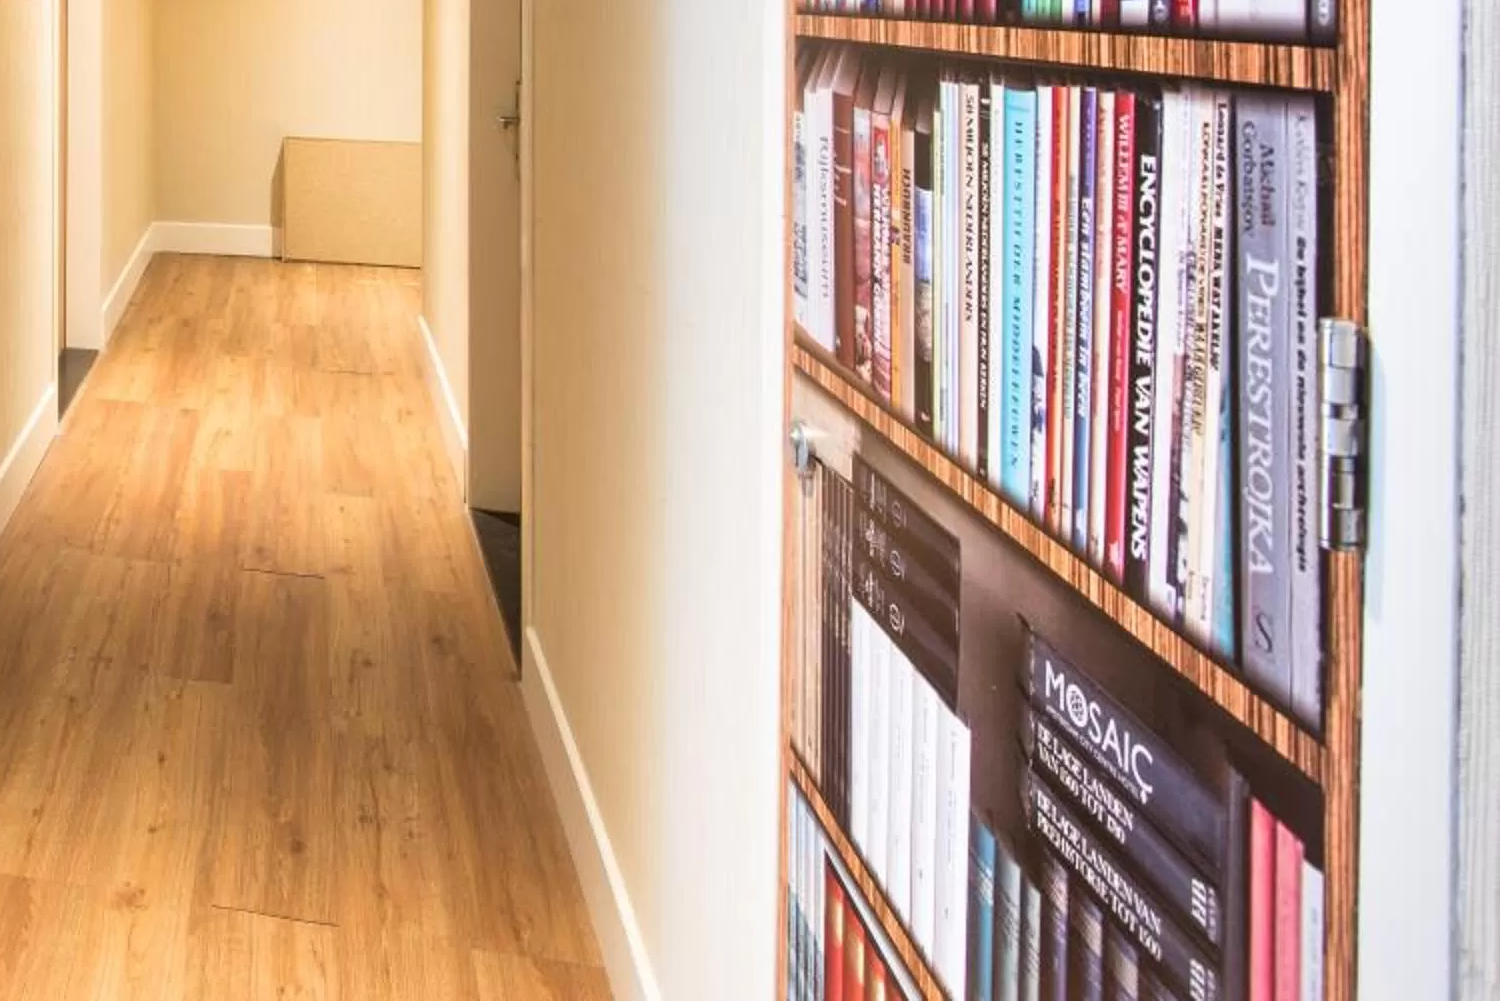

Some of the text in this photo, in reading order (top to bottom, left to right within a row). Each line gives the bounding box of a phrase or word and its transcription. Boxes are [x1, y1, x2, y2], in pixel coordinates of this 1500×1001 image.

[965, 118, 974, 188] MILJOEN
[1117, 113, 1130, 191] WILLEM
[1216, 103, 1228, 161] Leonard
[817, 135, 829, 298] Rijksmuseum
[1081, 196, 1092, 237] Een
[1215, 183, 1225, 217] Vries
[1259, 142, 1276, 227] Michail
[873, 184, 882, 278] HERMANN
[964, 193, 974, 324] NEDERLANDERS
[1013, 244, 1022, 286] DER
[1115, 236, 1128, 294] MARY
[1079, 242, 1092, 340] stamboom
[1011, 295, 1021, 469] MIDDELEEUWEN
[1078, 346, 1090, 365] in
[1131, 154, 1157, 561] ENCYCLOPEDIE VAN WAPENS
[1244, 251, 1280, 576] PERESTROJKA
[1037, 722, 1134, 831] DE LAGE LANDEN
[1079, 784, 1106, 823] TOT
[1037, 790, 1161, 936] DE LAGE LANDEN VAN
[1109, 894, 1138, 932] TOT
